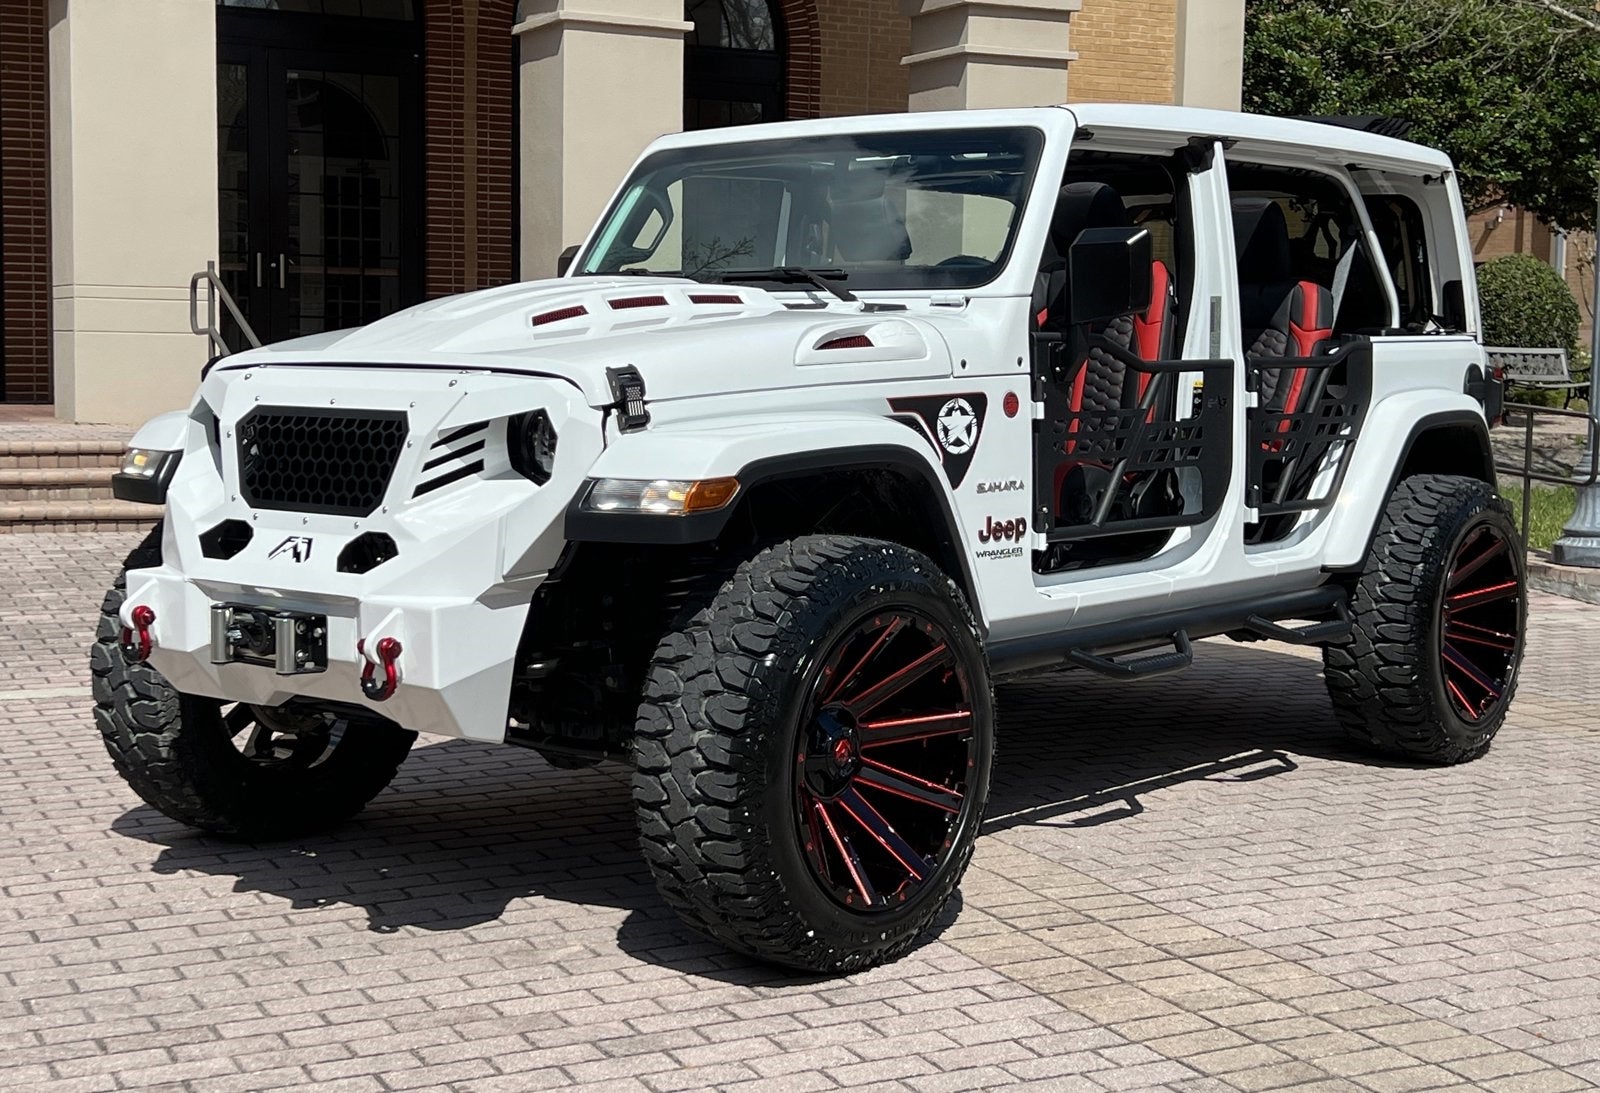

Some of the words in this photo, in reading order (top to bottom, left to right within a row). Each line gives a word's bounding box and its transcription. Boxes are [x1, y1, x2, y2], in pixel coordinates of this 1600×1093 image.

[976, 480, 1025, 494] SAHARA
[978, 516, 1027, 544] Jeep
[976, 547, 1023, 558] WRANGLER
